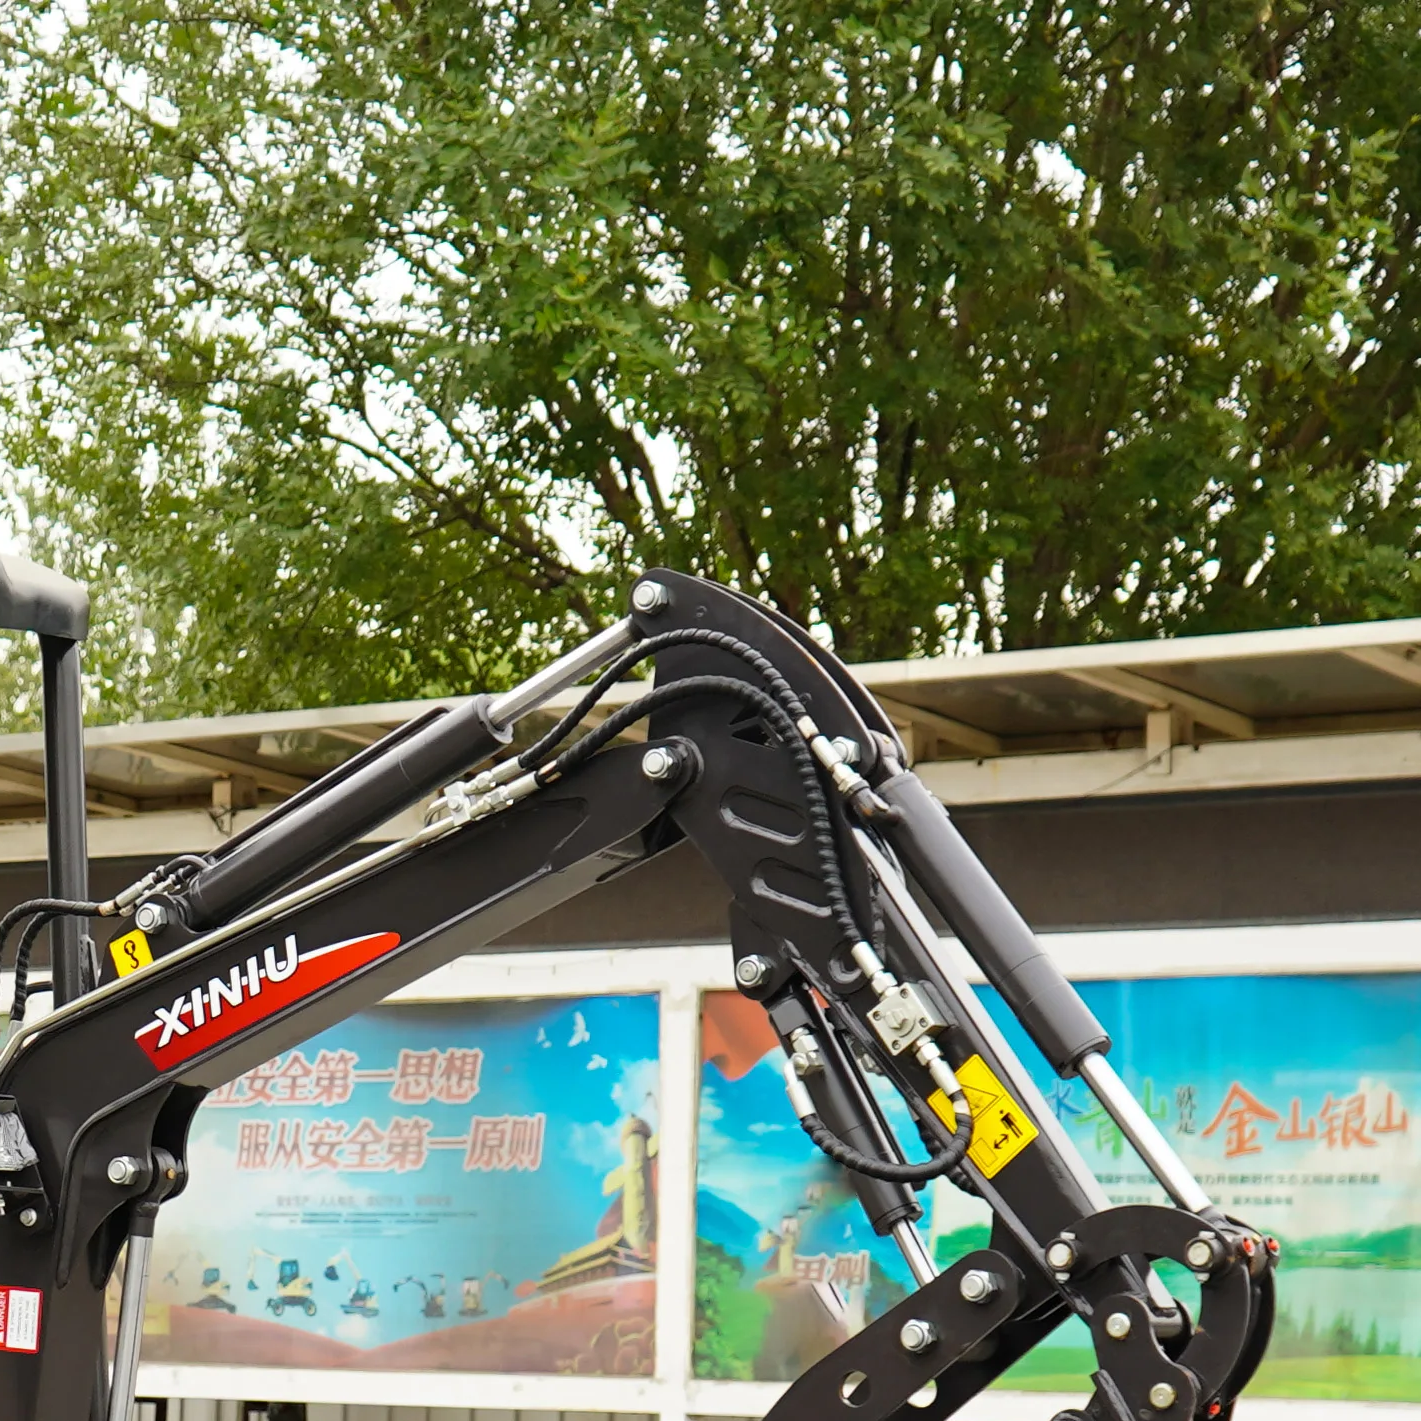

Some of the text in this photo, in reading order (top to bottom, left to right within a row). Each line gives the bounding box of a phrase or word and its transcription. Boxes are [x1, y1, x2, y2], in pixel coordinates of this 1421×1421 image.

[153, 933, 299, 1049] XINIU
[237, 1114, 545, 1170] 服从安全第一原则
[1200, 1080, 1409, 1160] 金山银山
